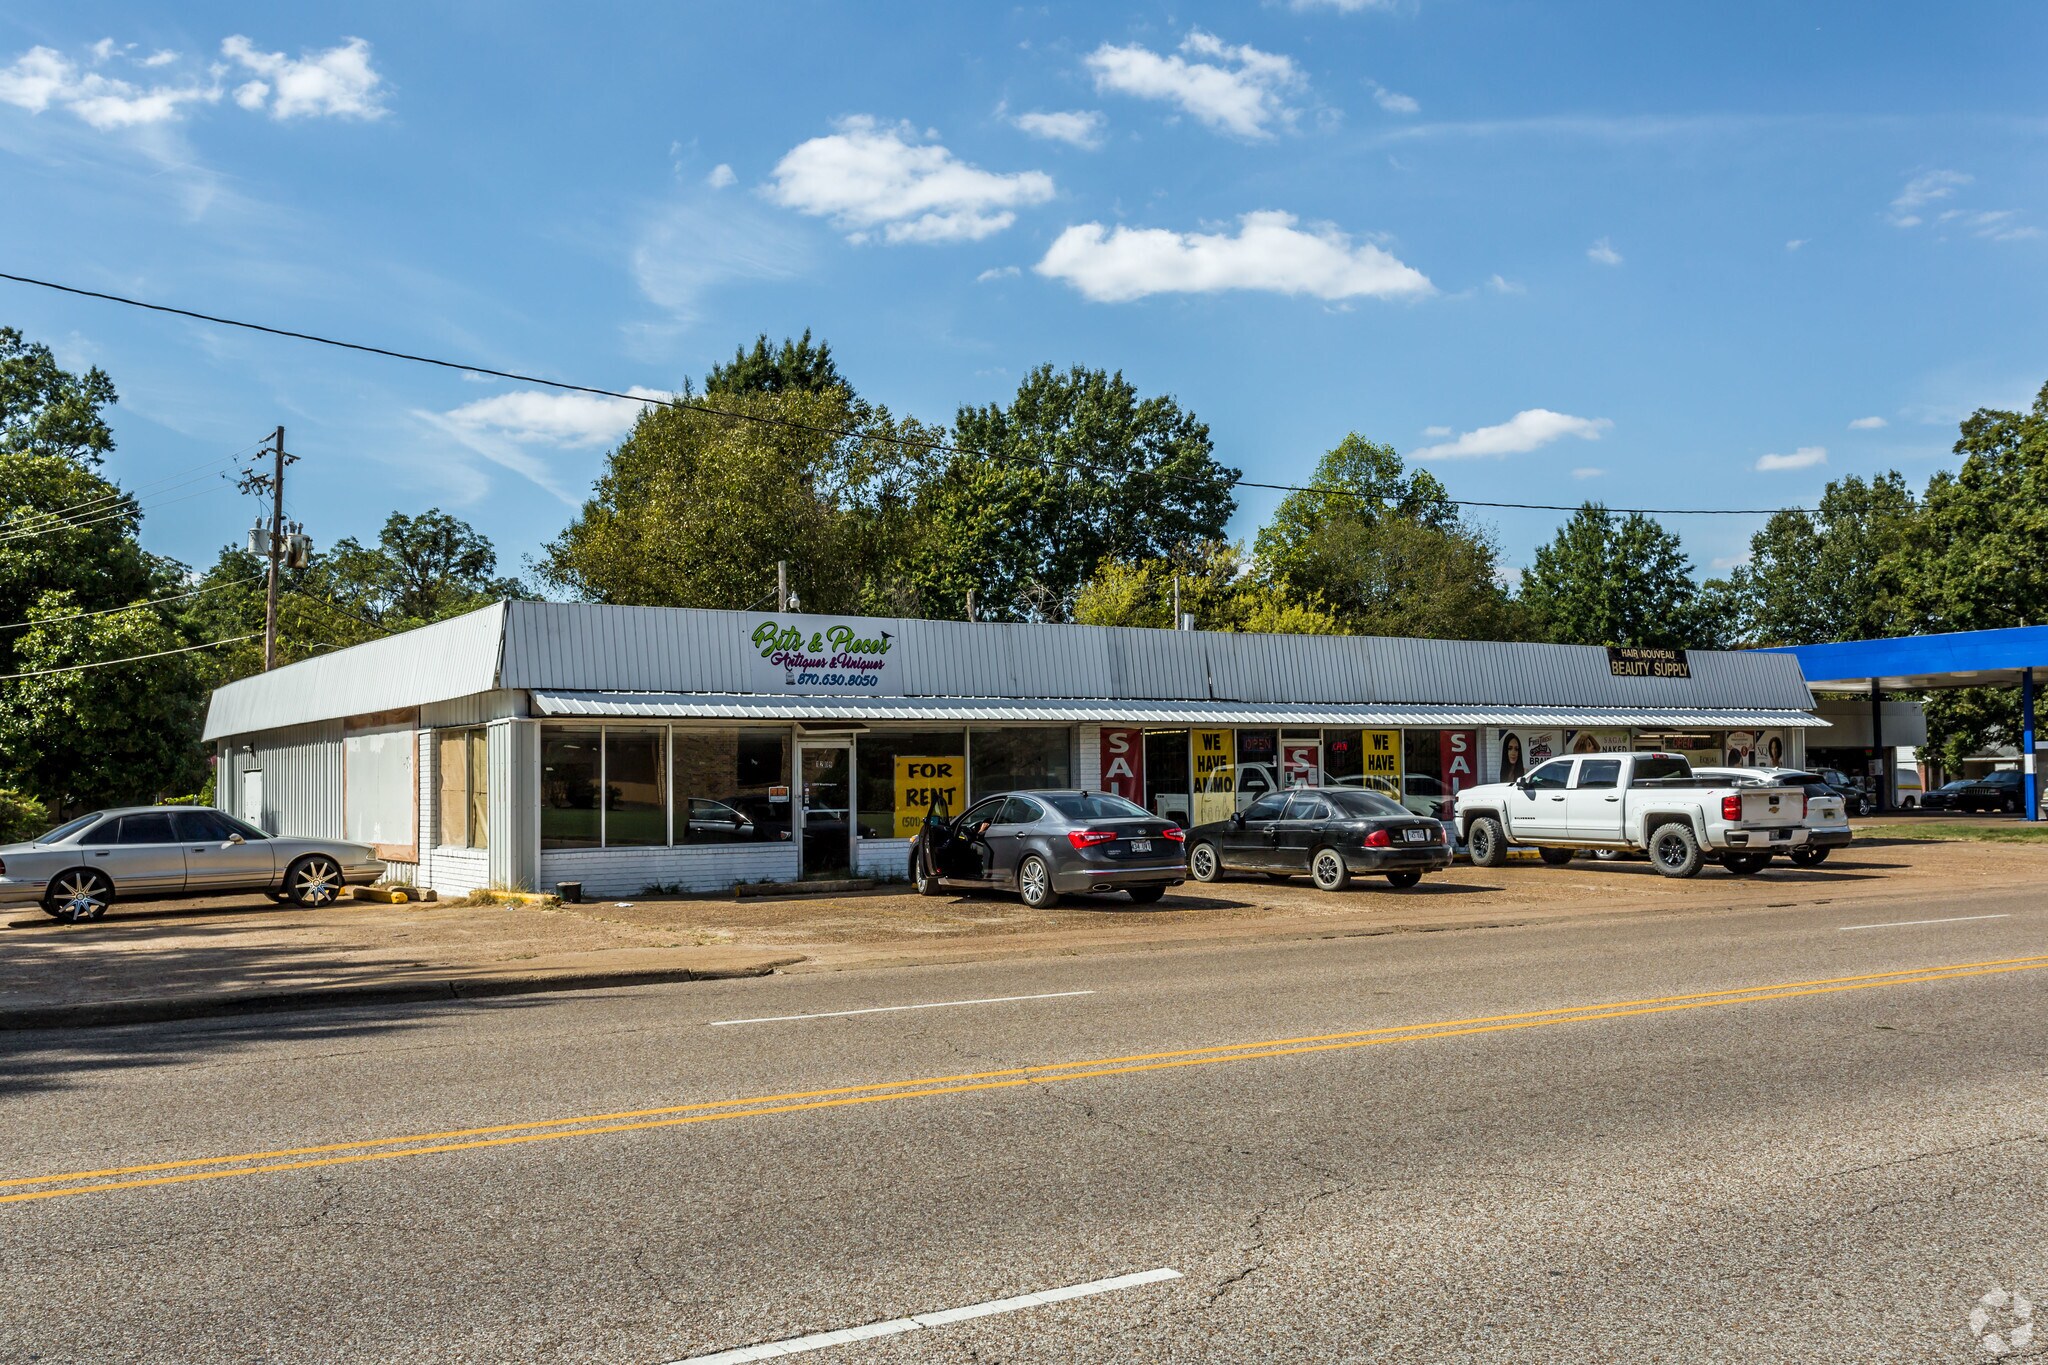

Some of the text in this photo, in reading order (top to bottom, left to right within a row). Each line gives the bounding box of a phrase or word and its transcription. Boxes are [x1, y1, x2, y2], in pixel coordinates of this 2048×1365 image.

[751, 621, 892, 658] Bits & Pieces
[1621, 649, 1675, 659] HAIR NOUVEAU
[770, 652, 828, 673] Antiques
[1611, 661, 1688, 677] BEAUTY SUPPLY
[797, 673, 878, 687] 870.630.8050
[1202, 733, 1221, 751] WE
[1245, 738, 1271, 749] OPEN
[1372, 734, 1389, 750] WE
[1602, 745, 1627, 753] NAKED
[908, 763, 953, 778] FOR
[1197, 755, 1228, 772] HAVE
[1368, 754, 1395, 771] HAVE
[1194, 776, 1232, 793] AMMO
[1365, 775, 1399, 790] AMMO
[906, 787, 957, 807] RENT
